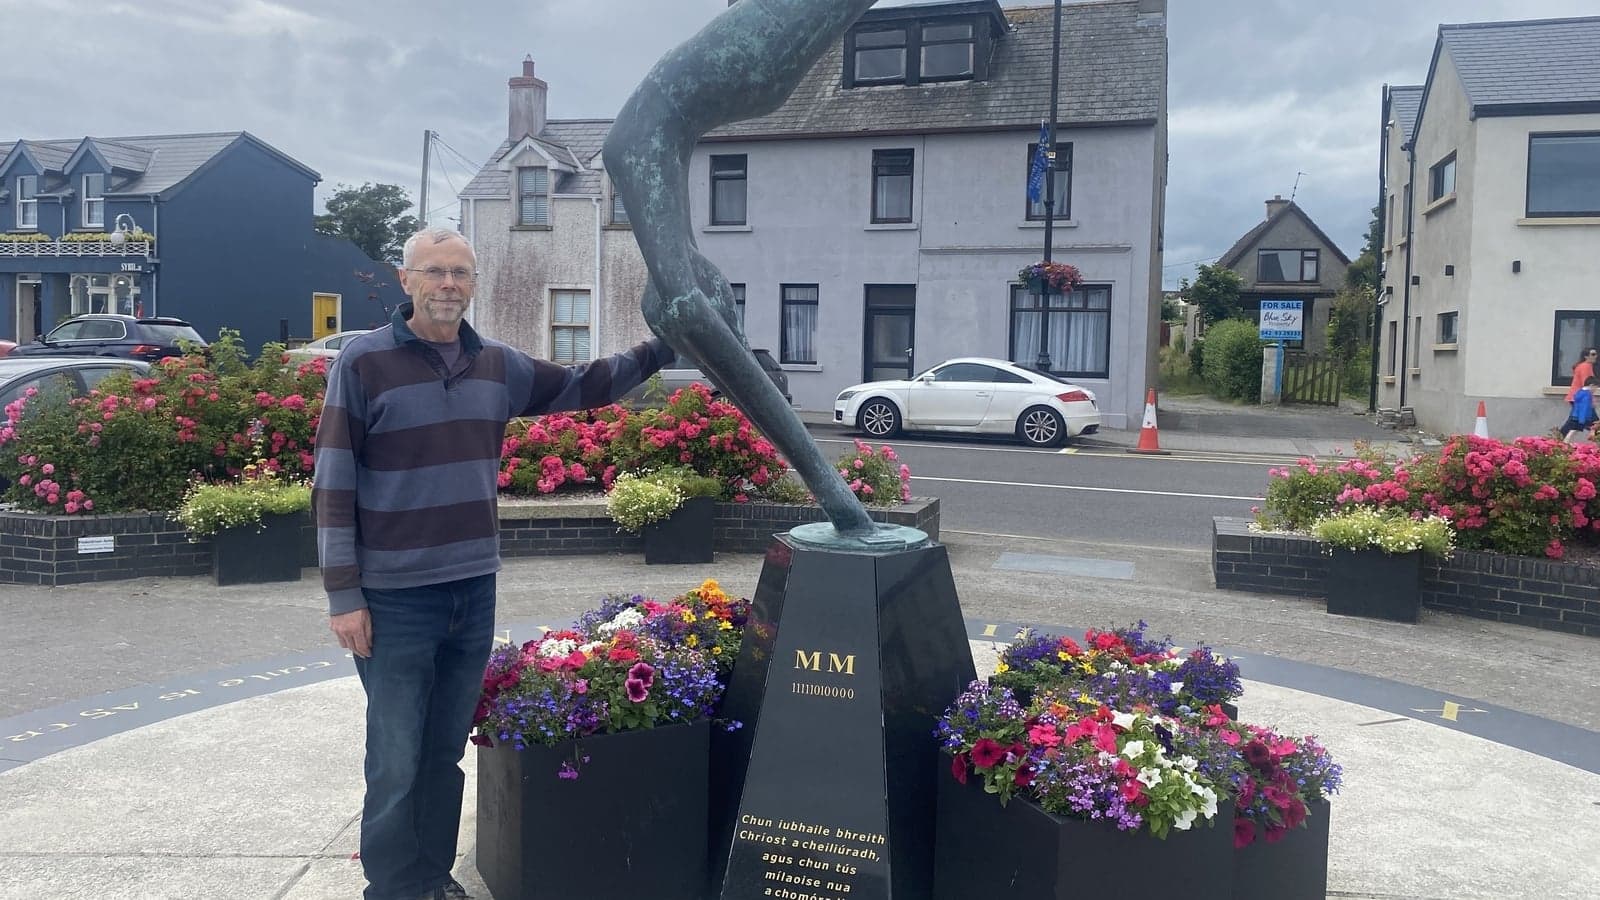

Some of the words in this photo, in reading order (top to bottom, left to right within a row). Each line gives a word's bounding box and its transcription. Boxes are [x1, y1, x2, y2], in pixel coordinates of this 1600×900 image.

[1281, 312, 1297, 325] Sky
[792, 682, 854, 699] 11111010000
[742, 814, 772, 827] Chun
[778, 819, 830, 836] iubhaile
[836, 828, 885, 845] bhreith
[740, 830, 787, 846] Chríost
[792, 839, 799, 848] a
[802, 839, 881, 863] cheiliúradh,
[762, 852, 793, 865] agus
[799, 857, 829, 871] chun
[836, 862, 857, 875] tús
[764, 887, 772, 896] a
[765, 870, 821, 888] mílaoise
[826, 881, 851, 893] nua
